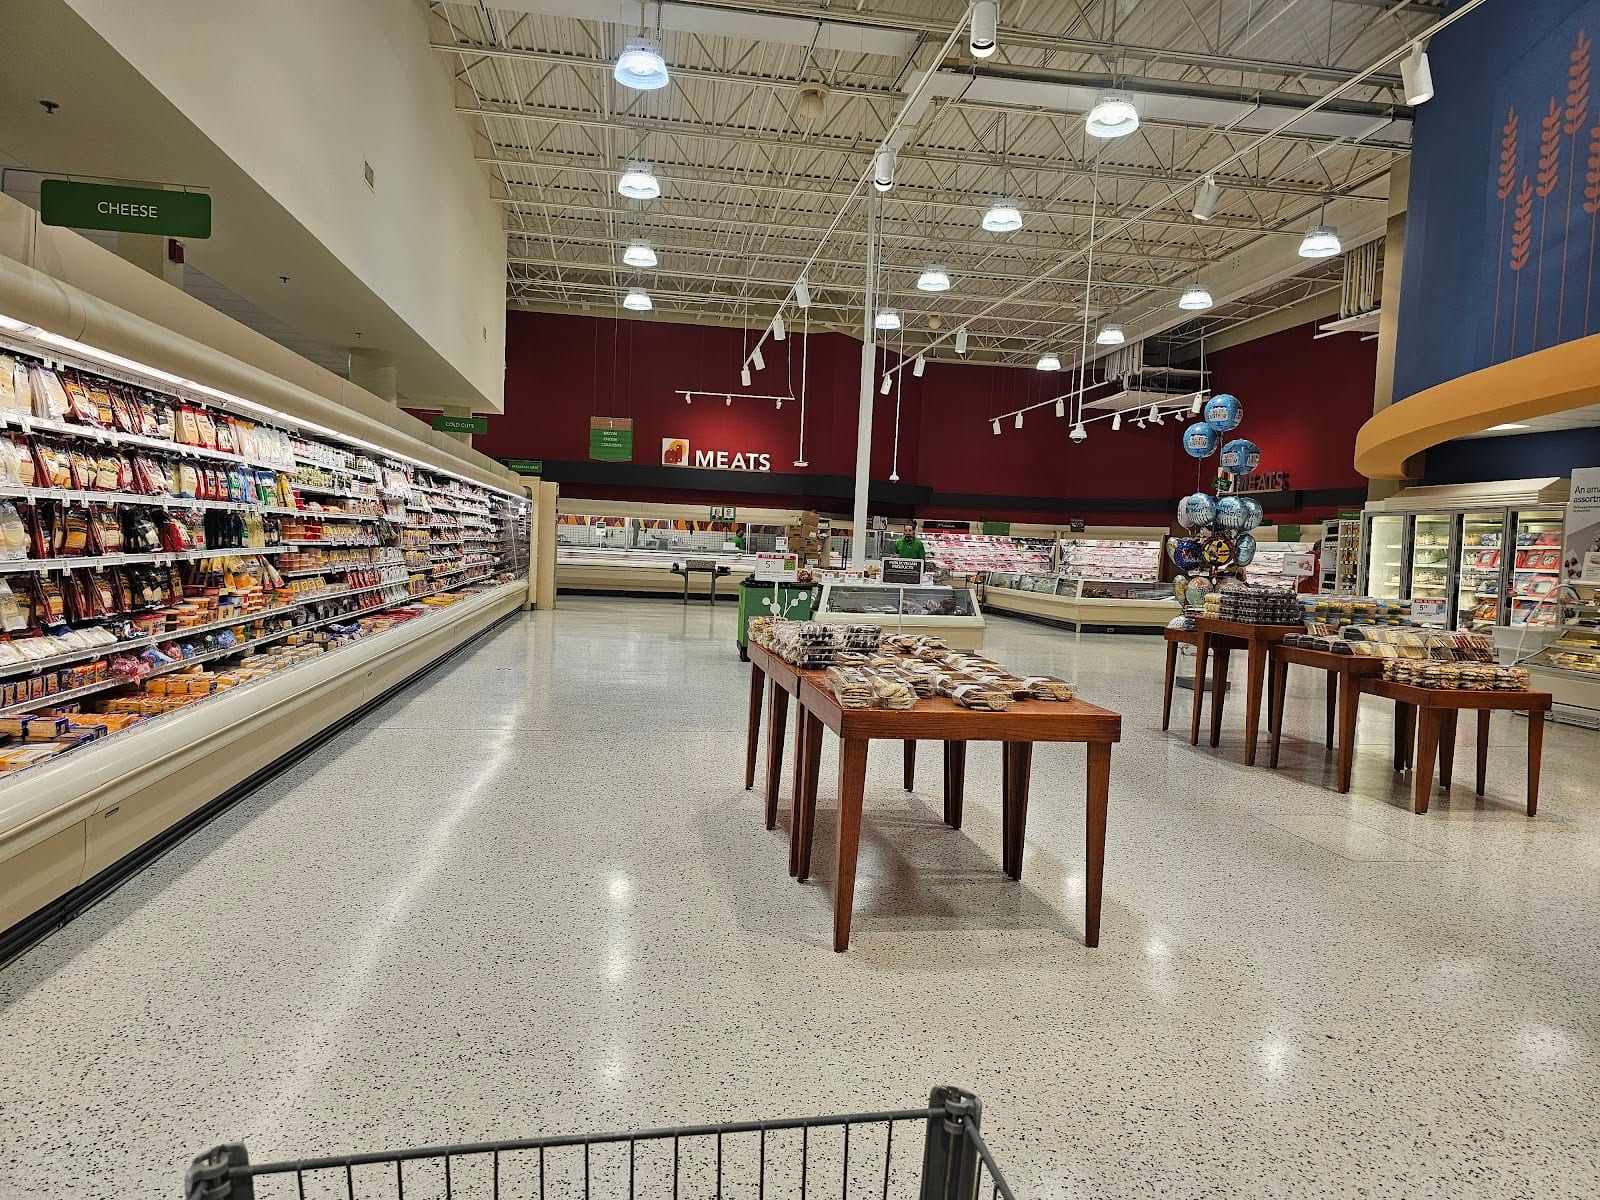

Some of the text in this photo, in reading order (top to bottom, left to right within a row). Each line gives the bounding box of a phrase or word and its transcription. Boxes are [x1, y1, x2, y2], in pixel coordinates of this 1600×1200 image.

[97, 201, 158, 218] CHEESE
[609, 420, 613, 429] 1
[695, 449, 771, 472] MEATS
[1238, 472, 1283, 491] MEATS
[1574, 485, 1585, 494] An
